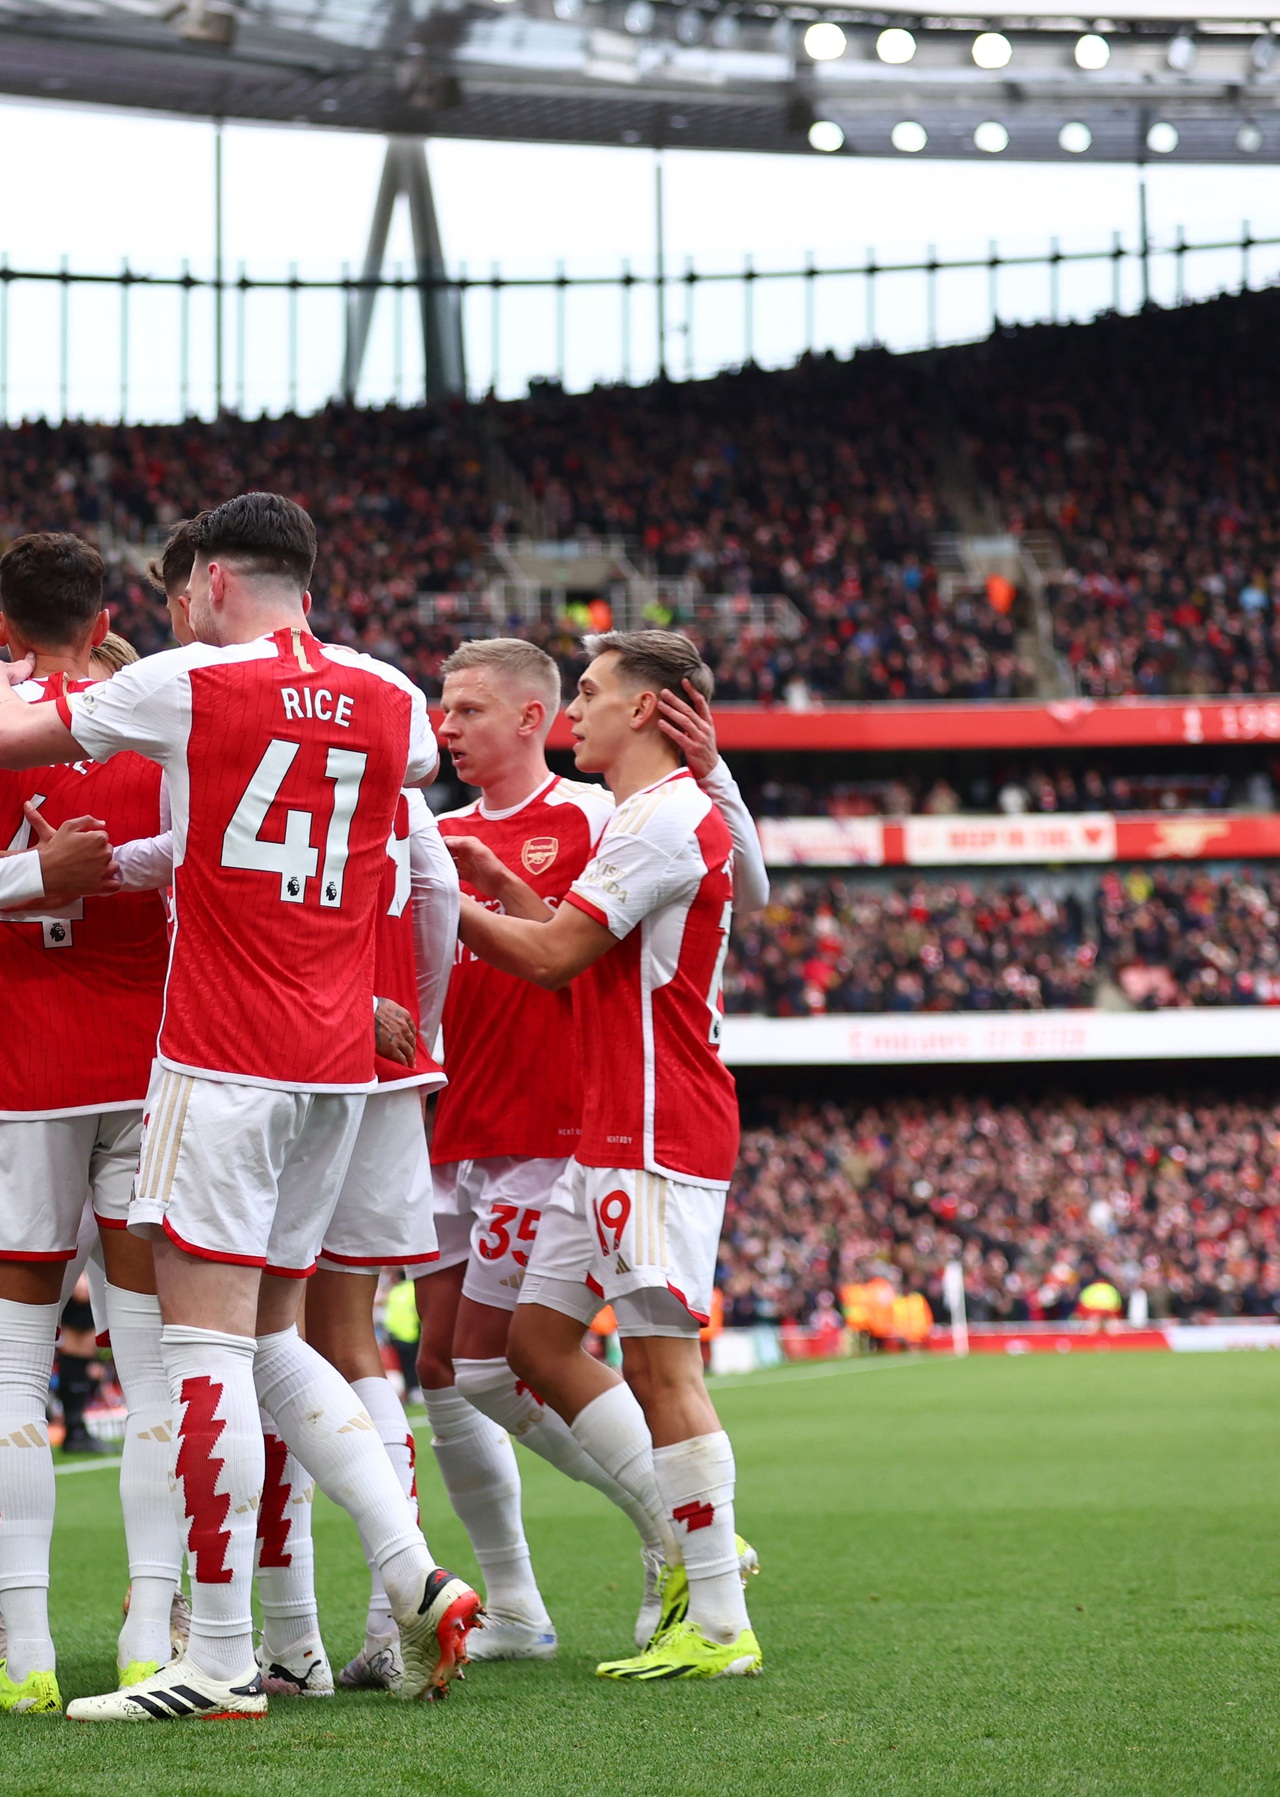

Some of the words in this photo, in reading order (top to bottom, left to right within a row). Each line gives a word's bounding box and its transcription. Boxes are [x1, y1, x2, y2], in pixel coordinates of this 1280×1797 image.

[280, 687, 354, 728] RICE
[220, 738, 368, 908] 41
[479, 1203, 542, 1267] 35
[592, 1189, 632, 1257] 19
